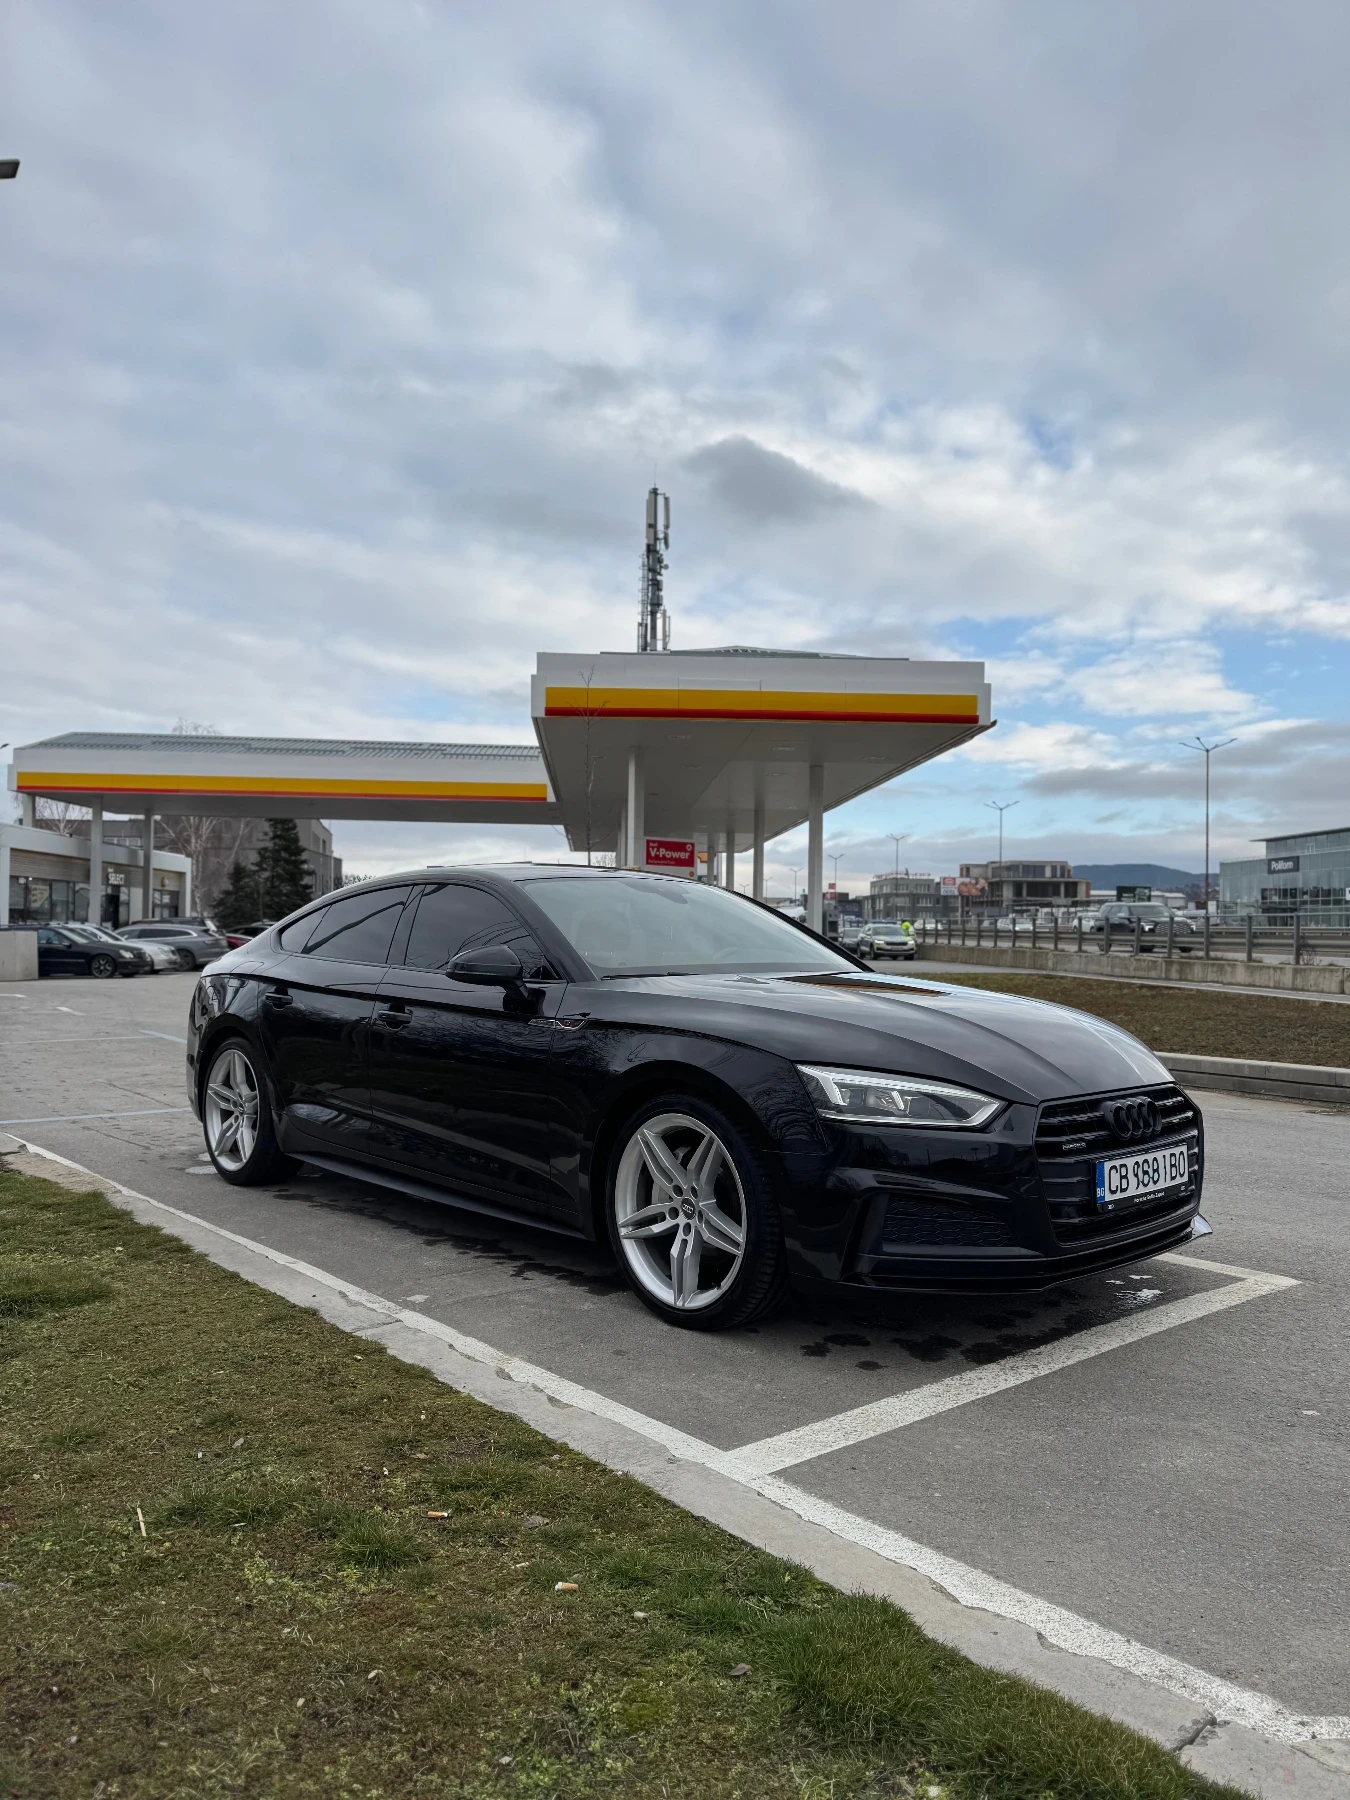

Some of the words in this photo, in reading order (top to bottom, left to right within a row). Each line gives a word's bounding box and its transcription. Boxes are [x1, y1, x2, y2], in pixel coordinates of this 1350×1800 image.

[649, 848, 690, 859] V-Power
[1271, 860, 1293, 871] Poliform
[108, 873, 125, 885] SELECT
[1096, 1187, 1105, 1198] BG
